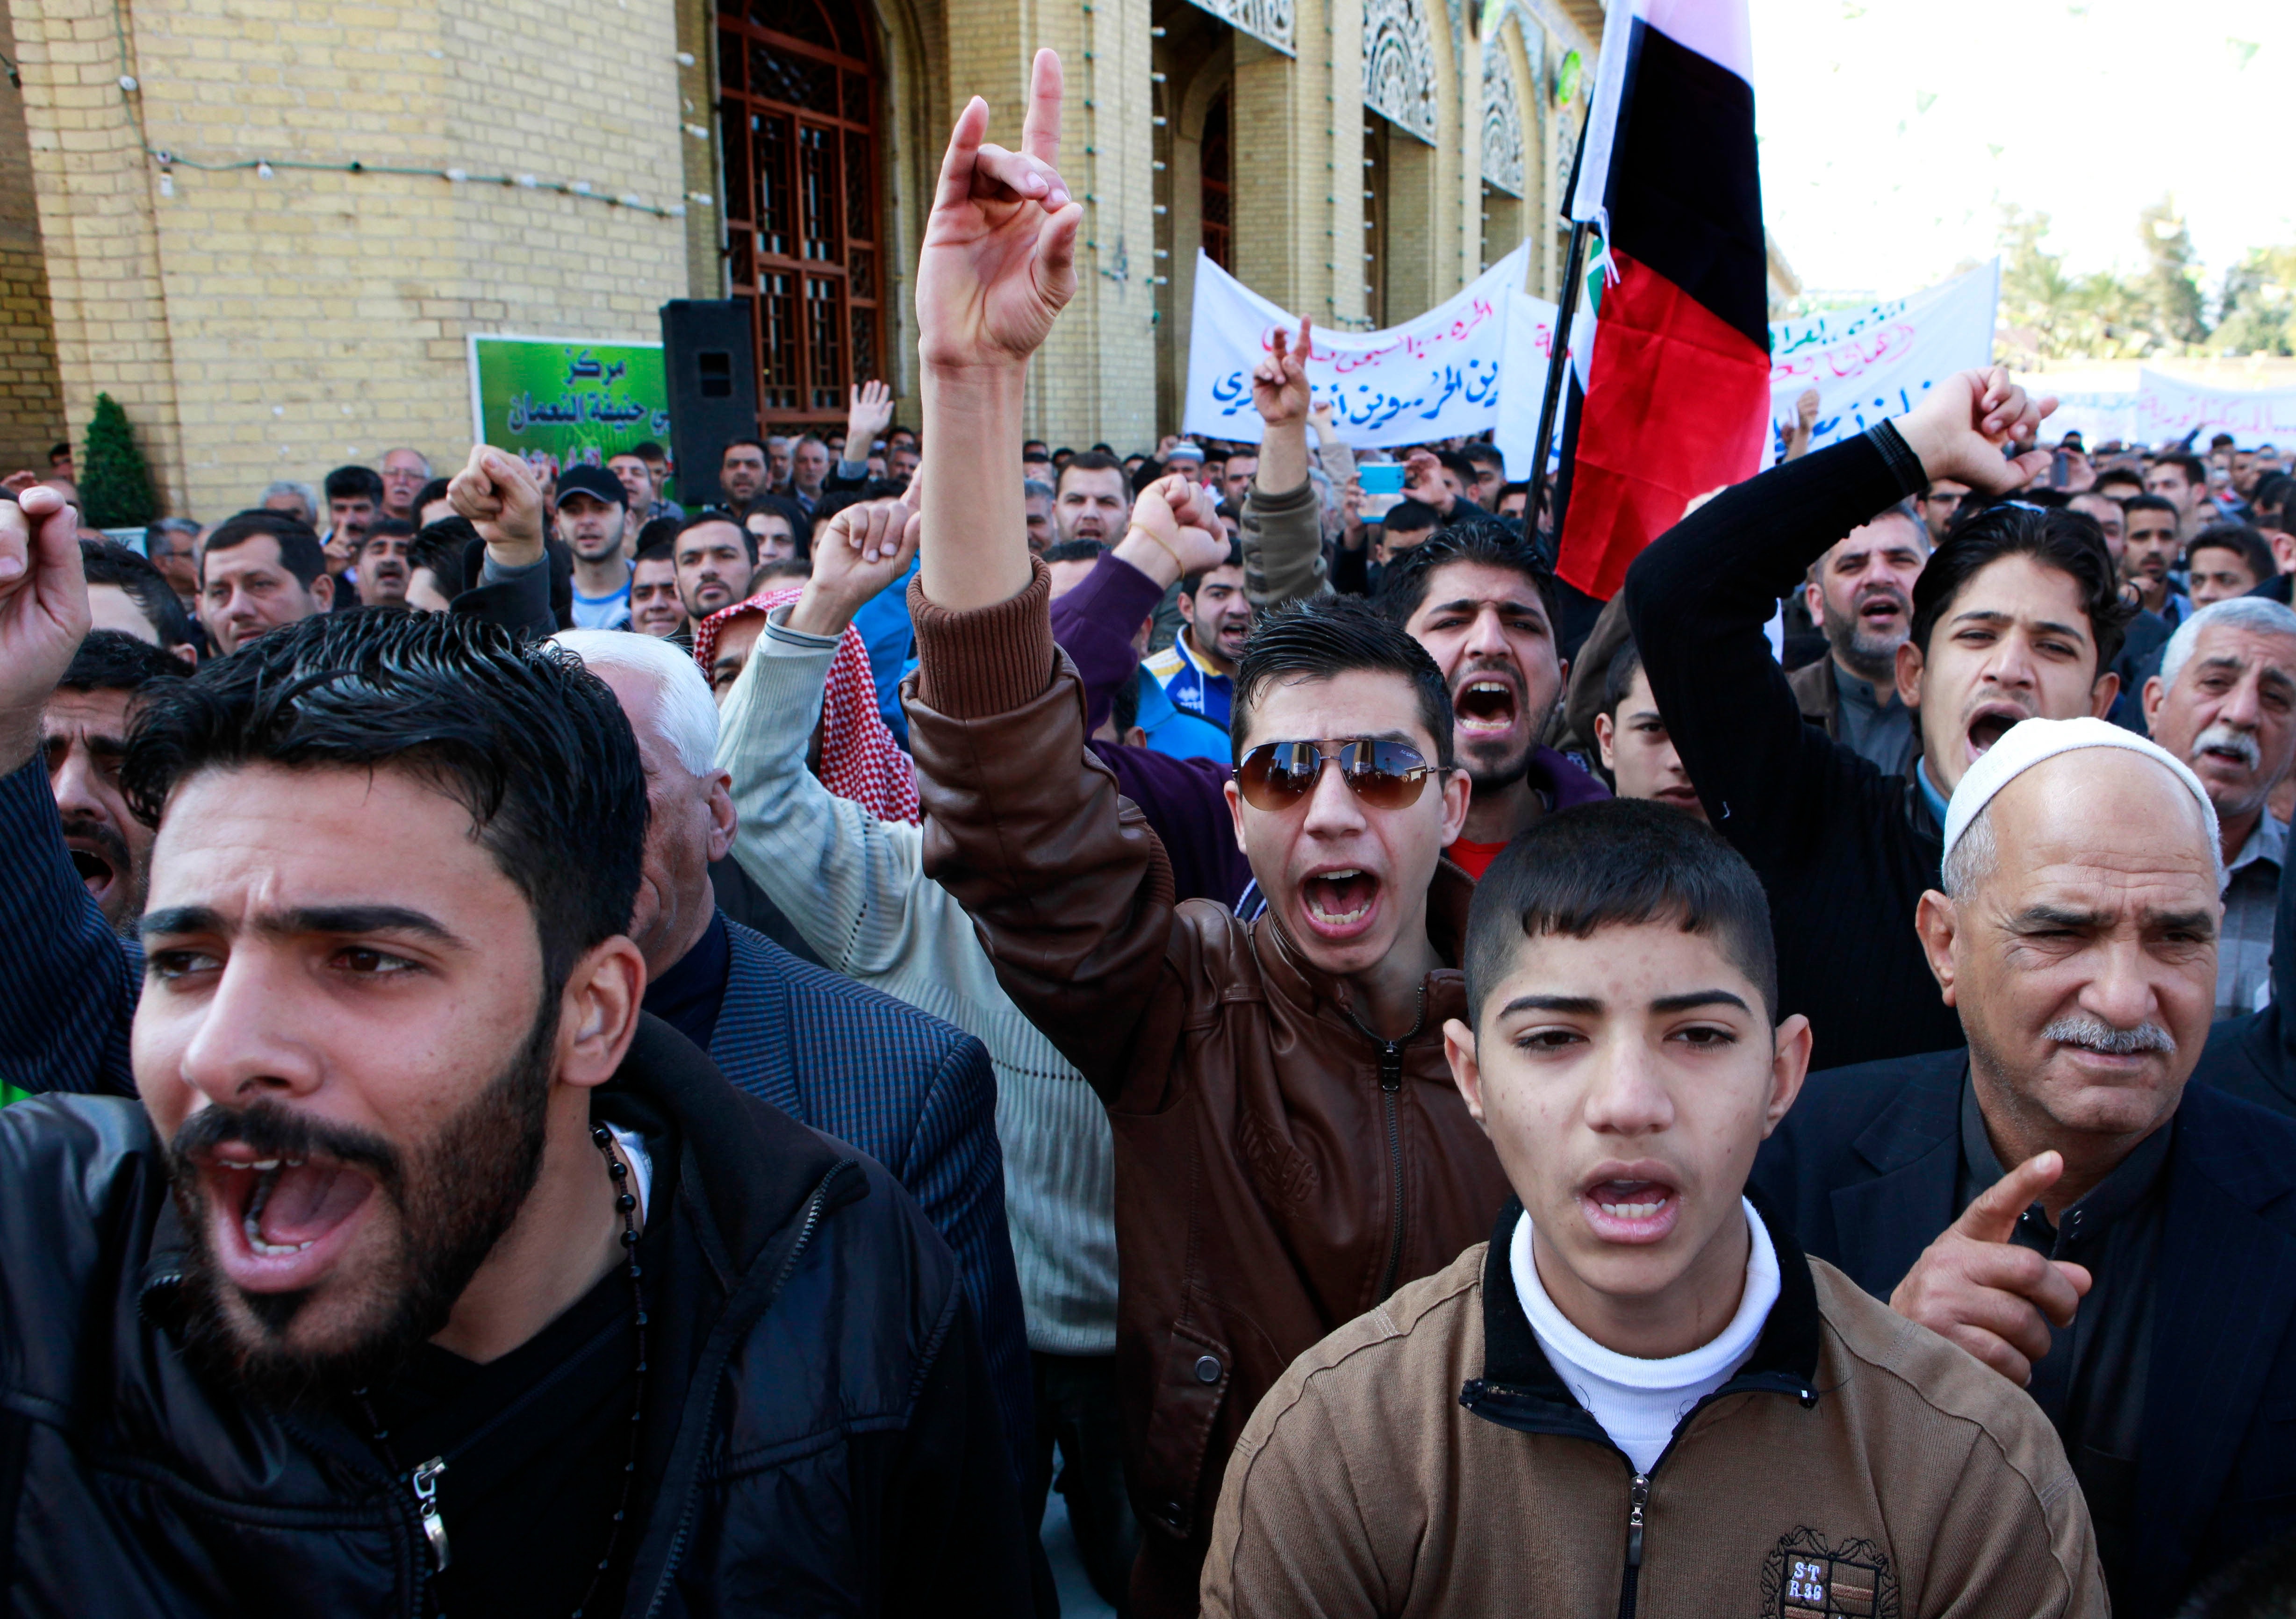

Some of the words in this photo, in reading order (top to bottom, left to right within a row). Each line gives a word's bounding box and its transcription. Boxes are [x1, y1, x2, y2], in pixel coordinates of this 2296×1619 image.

[563, 348, 625, 387] مركز
[508, 389, 585, 435] النعمان
[588, 392, 646, 431] حنيفة
